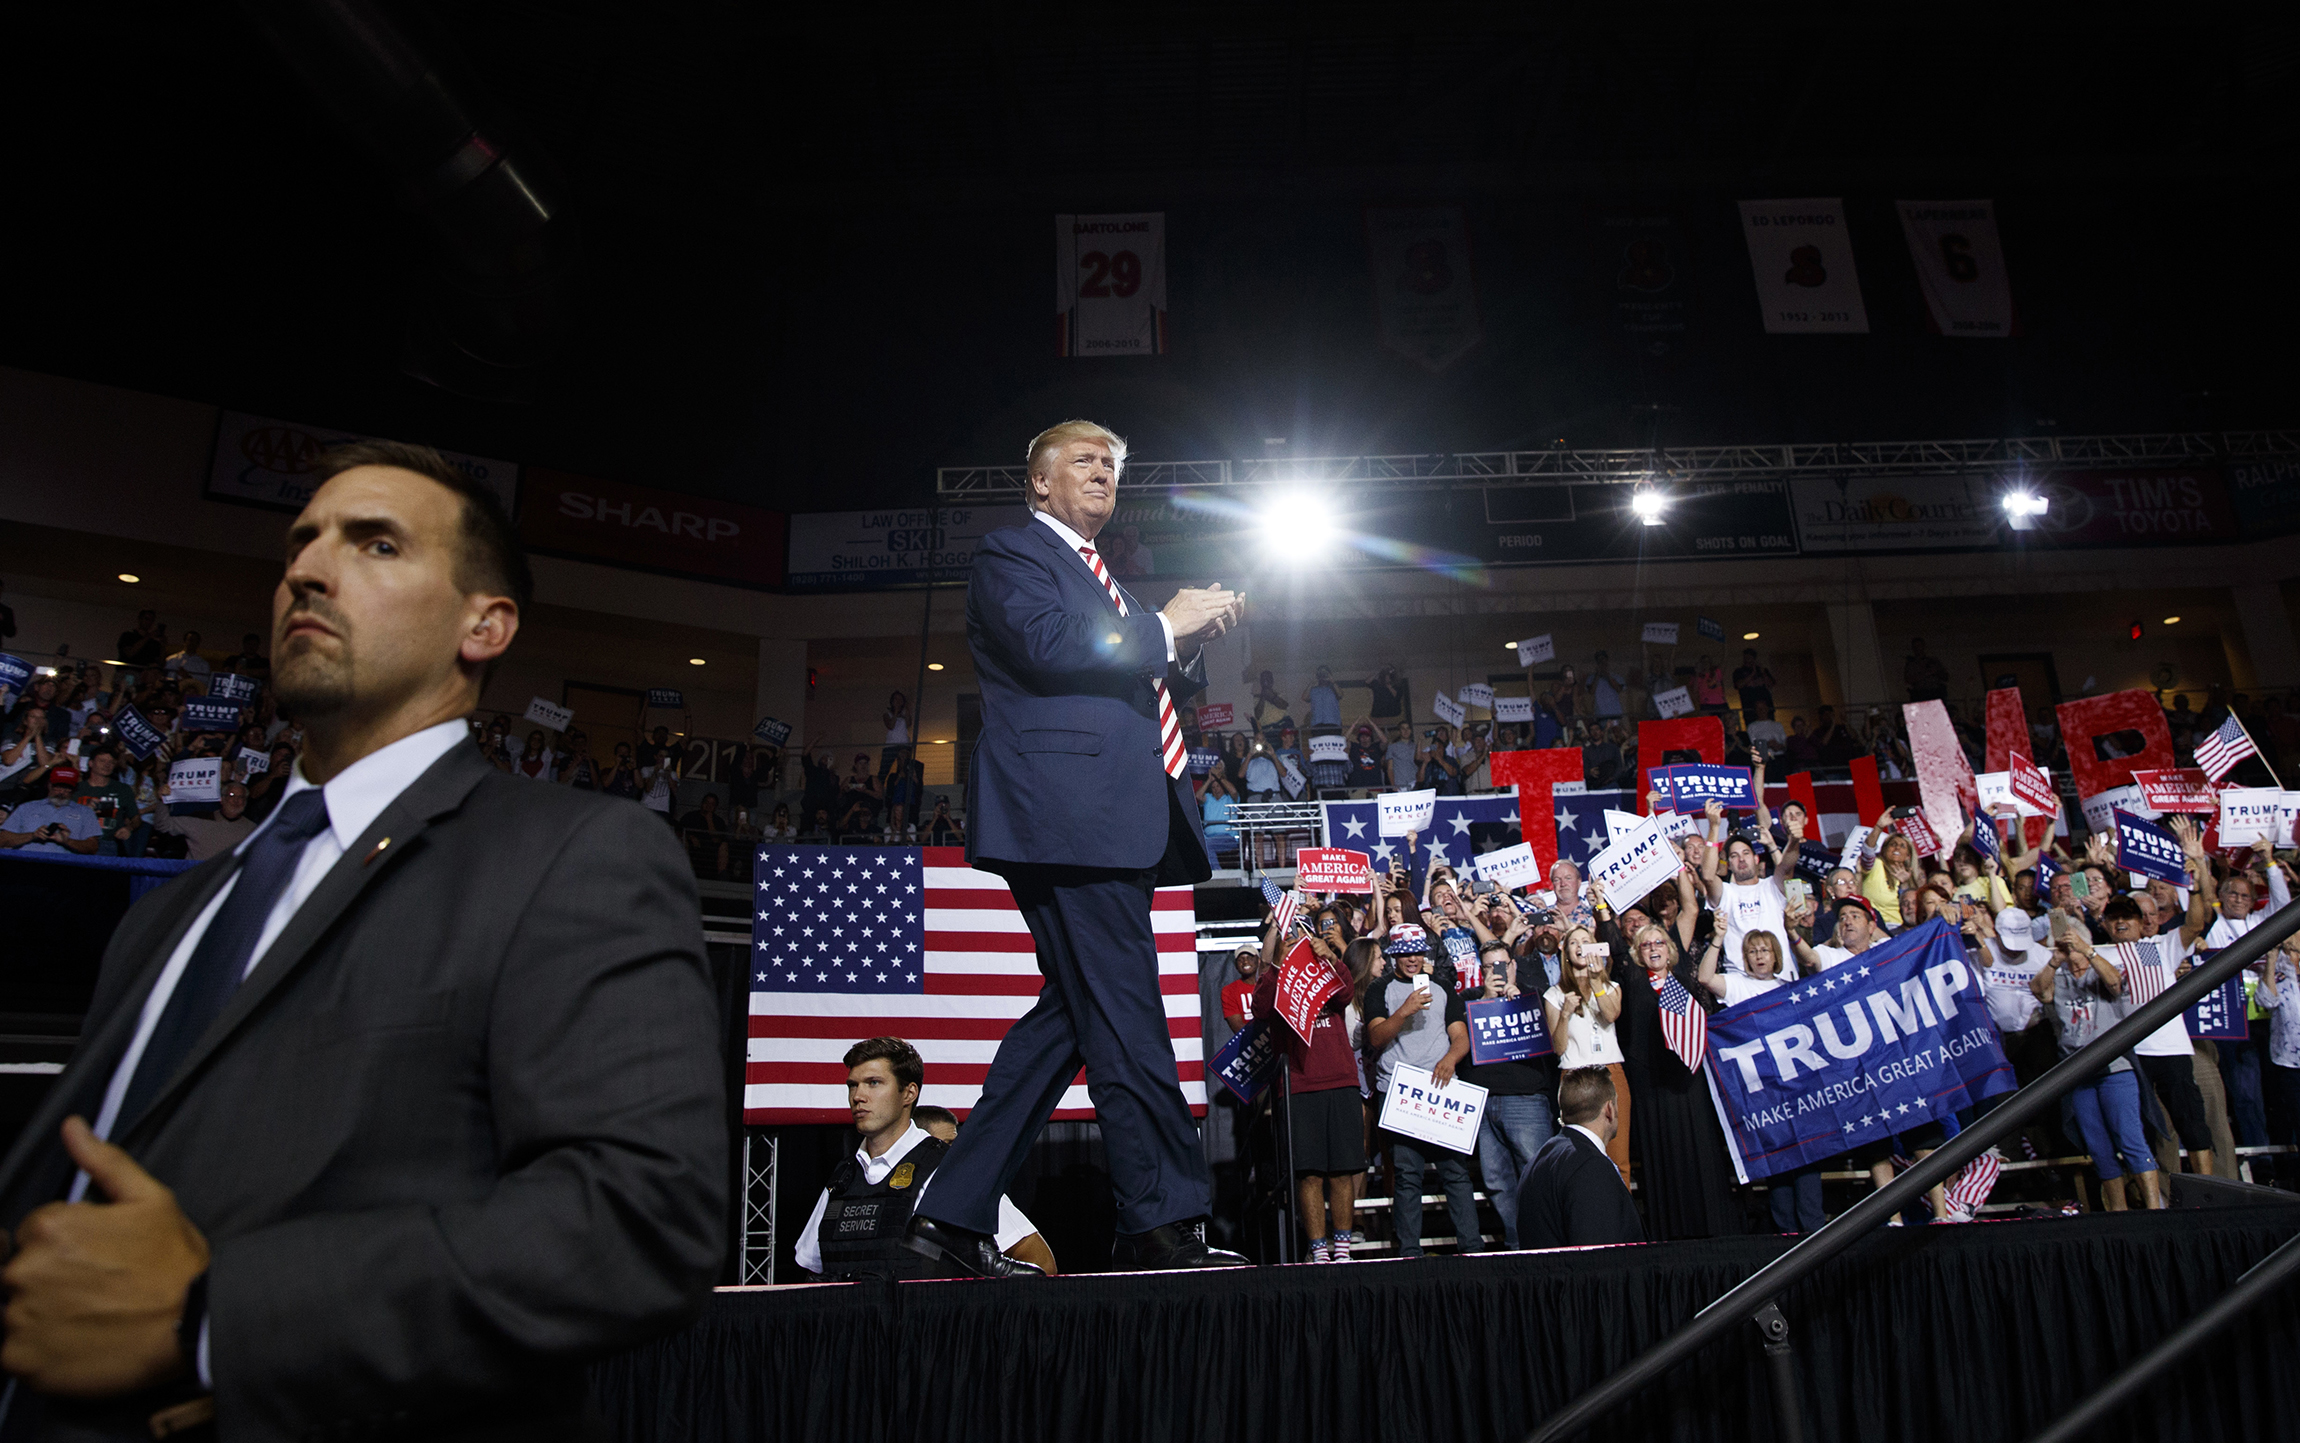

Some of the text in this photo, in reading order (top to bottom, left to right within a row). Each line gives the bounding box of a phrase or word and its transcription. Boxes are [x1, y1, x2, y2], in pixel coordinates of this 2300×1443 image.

[1072, 222, 1150, 235] BARTOLONE
[1938, 234, 1979, 284] 6
[1079, 250, 1142, 298] 29
[1733, 481, 1784, 494] PENALTY
[2105, 477, 2198, 510] TIM'S
[557, 491, 741, 542] SHARP
[862, 513, 893, 529] LAW
[952, 510, 972, 525] OF
[1824, 499, 1886, 527] Daily
[2113, 509, 2212, 536] TOYOTA
[1499, 535, 1542, 548] PERIOD
[1696, 535, 1792, 550] SHOTS ON GOAL
[832, 554, 892, 570] SHILOH
[187, 703, 239, 714] TRUMP
[533, 703, 569, 721] TRUMP
[123, 709, 162, 744] TRUMP
[169, 770, 217, 781] TRUMP
[1673, 774, 1750, 788] TRUMP
[1553, 785, 1585, 794] RUMP
[1682, 786, 1743, 795] PENCE
[1384, 802, 1433, 814] TRUMP
[2087, 798, 2129, 816] TRUMP
[2151, 795, 2180, 804] GREAT
[1388, 812, 1429, 821] PENCE
[2227, 804, 2279, 816] TRUMP
[2232, 816, 2276, 825] PENCE
[1321, 854, 1347, 862] MAKE
[1599, 833, 1659, 881] TRUMP
[2128, 839, 2184, 863] PENCE
[1300, 862, 1369, 875] AMERICA
[1482, 855, 1531, 874] TRUMP
[1609, 848, 1659, 887] PENCE
[1798, 855, 1835, 868] UMP
[1306, 875, 1335, 885] GREAT
[1488, 863, 1529, 879] PENCE
[1283, 965, 1299, 995] MAKE
[1288, 955, 1328, 1029] AMERICA
[1299, 997, 1311, 1032] GREAT
[1474, 1008, 1542, 1031] TRUMP
[1482, 1022, 1541, 1040] PENCE
[1718, 959, 1971, 1094] TRUMP
[1496, 1037, 1517, 1045] AMERICA
[1221, 1026, 1271, 1079] TRUM
[1235, 1045, 1272, 1082] PENC
[1398, 1083, 1477, 1115] TRUMP
[1742, 1105, 1795, 1133] MAKE
[1797, 1073, 1879, 1116] AMERICA
[1878, 1051, 1936, 1085] GREAT
[1400, 1098, 1465, 1125] PENCE
[843, 1204, 879, 1218] SECRET
[839, 1219, 876, 1233] SERVICE
